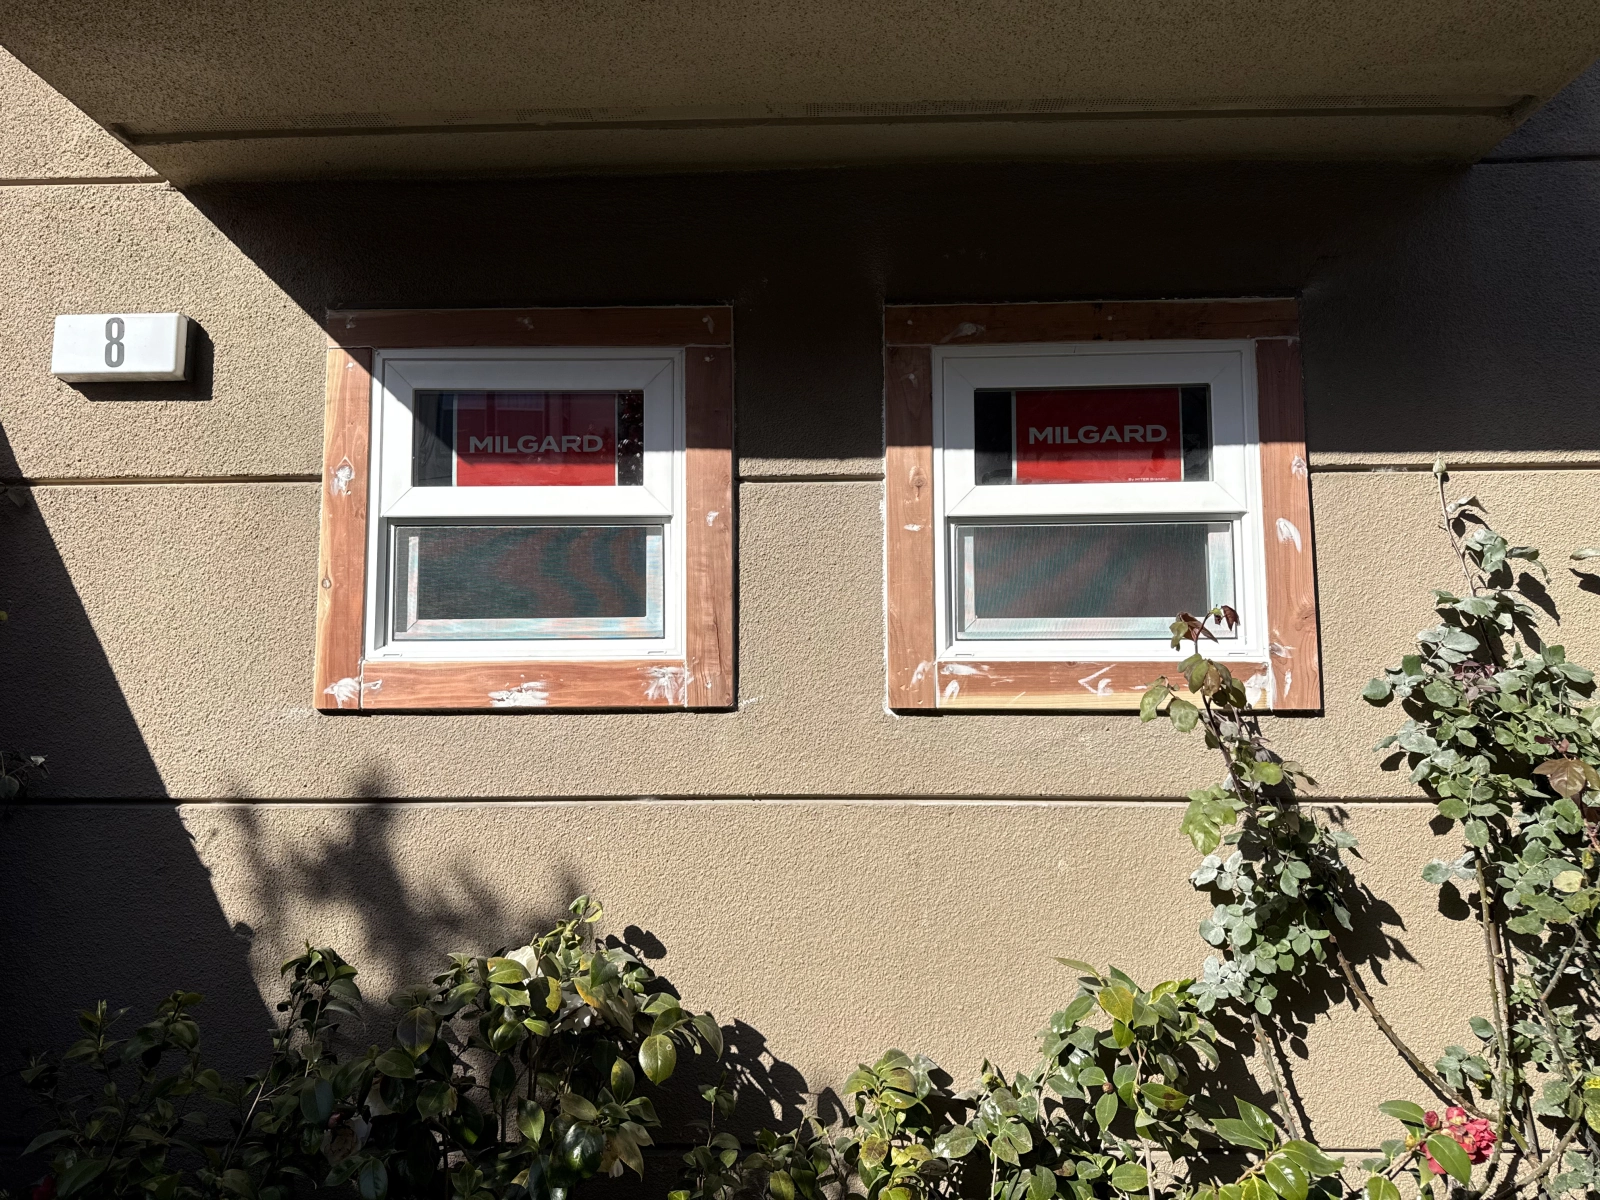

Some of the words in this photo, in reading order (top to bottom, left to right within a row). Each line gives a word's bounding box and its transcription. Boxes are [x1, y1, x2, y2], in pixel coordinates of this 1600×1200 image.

[104, 317, 125, 368] 8
[469, 435, 604, 453] MILGARD
[1028, 425, 1168, 444] MILGARD
